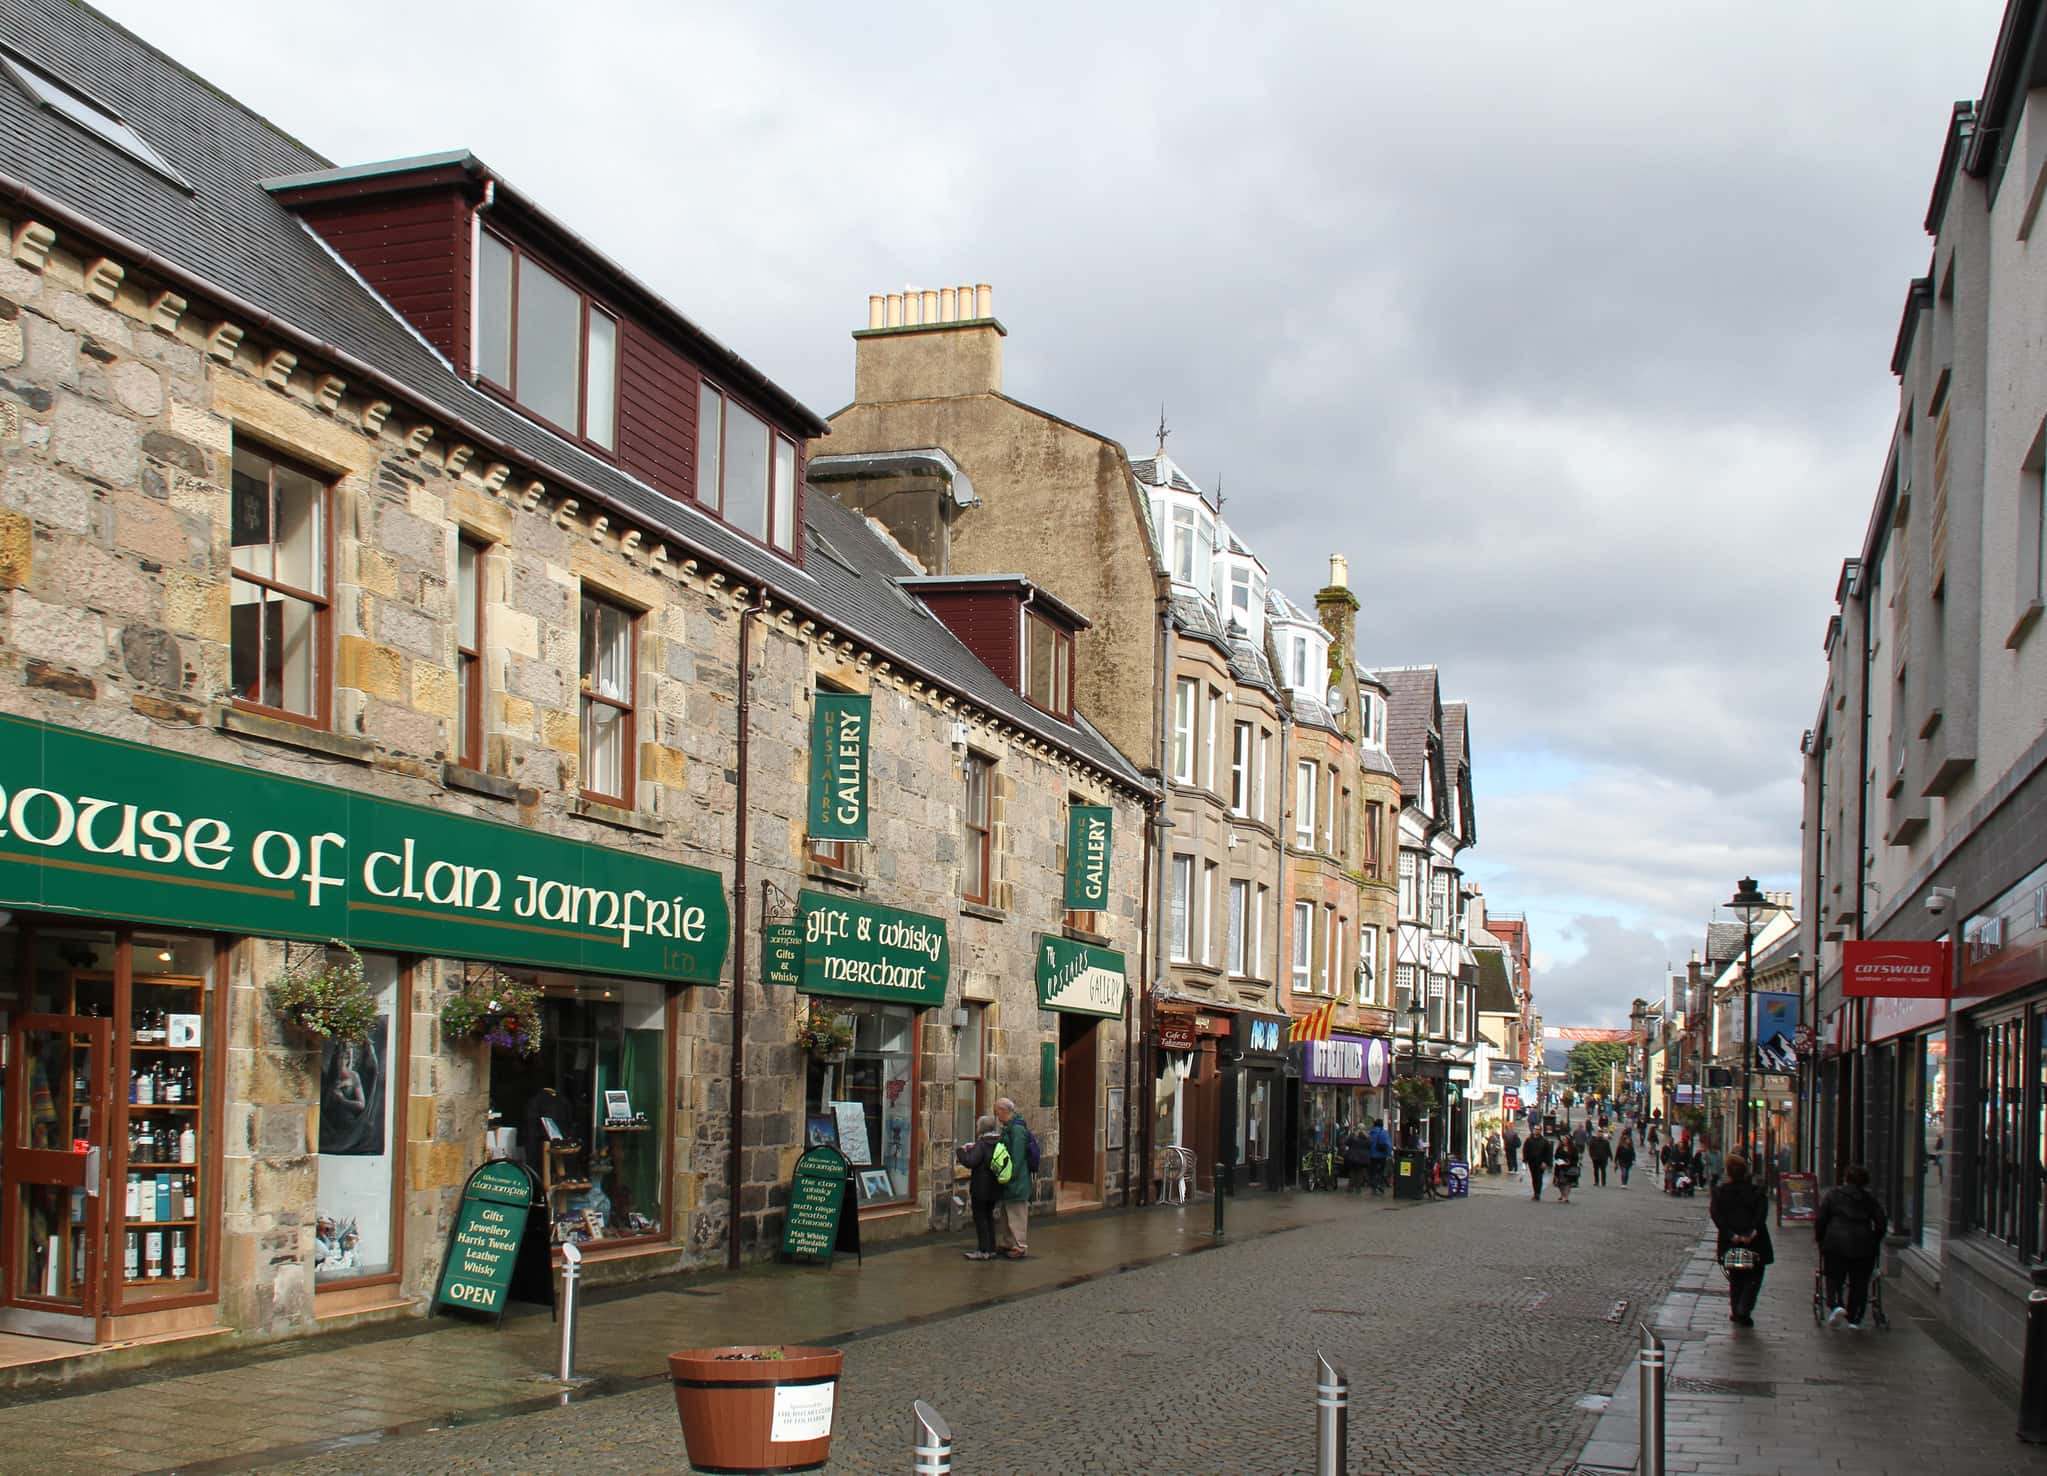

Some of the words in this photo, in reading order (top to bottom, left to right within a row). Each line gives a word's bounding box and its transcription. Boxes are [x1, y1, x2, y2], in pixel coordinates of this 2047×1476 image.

[821, 711, 835, 824] UPSTAIRS
[837, 709, 862, 825] GALLERY
[0, 784, 236, 871] ouse
[252, 830, 347, 906] of
[363, 838, 502, 912] clan
[1085, 816, 1106, 900] GALLERY
[806, 906, 849, 946] gift
[857, 916, 872, 942] &
[879, 919, 942, 962] whisky
[775, 948, 796, 960] Gifts
[770, 971, 799, 985] Whisky
[824, 954, 926, 990] merchant
[1047, 949, 1088, 999] UPSTAIRS
[1855, 964, 1932, 974] COTSWOLD
[1089, 974, 1120, 1007] GALLERY
[482, 1209, 505, 1221] Gifts
[469, 1220, 511, 1238] Jewellery
[457, 1232, 486, 1246] Harris
[488, 1237, 516, 1251] Tweed
[465, 1248, 501, 1262] Leather
[463, 1260, 496, 1277] Whisky
[450, 1282, 497, 1306] OPEN
